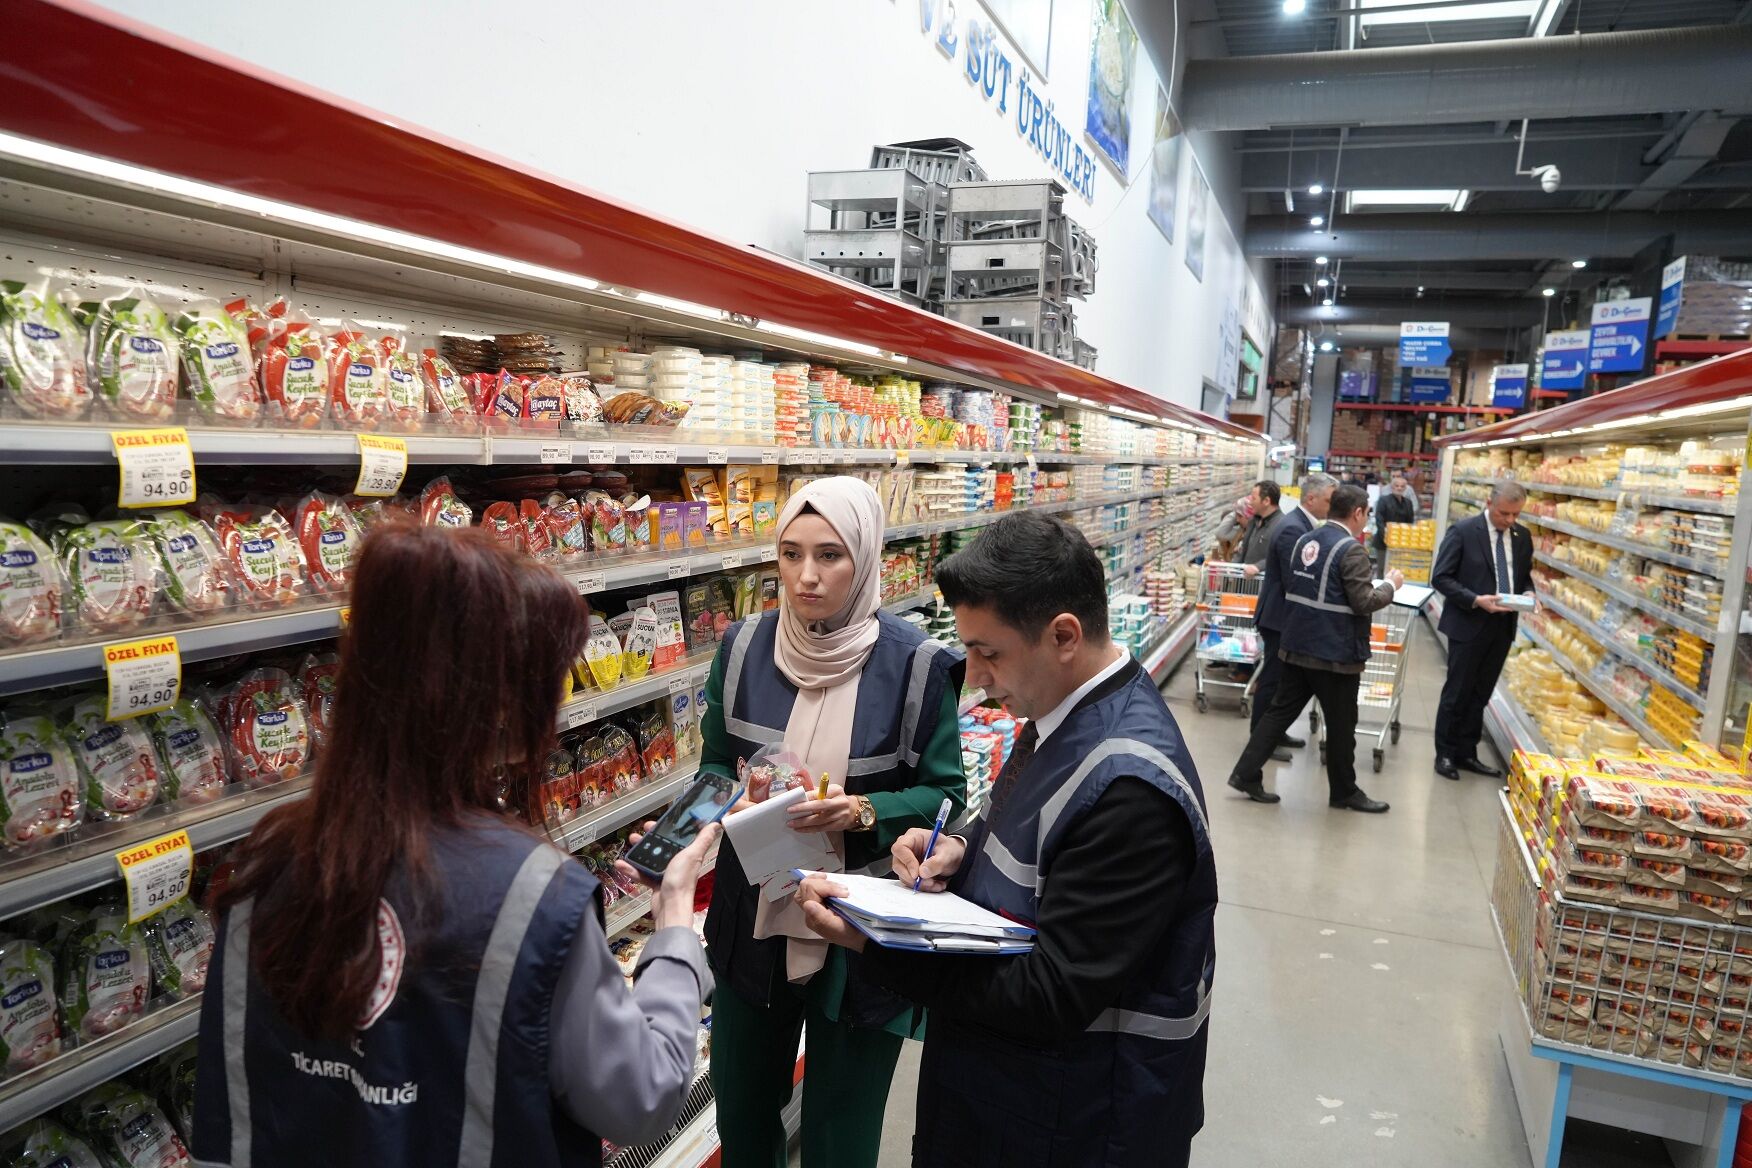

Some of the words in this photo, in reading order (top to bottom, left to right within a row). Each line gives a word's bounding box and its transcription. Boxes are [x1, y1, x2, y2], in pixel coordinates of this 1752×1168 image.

[967, 19, 1012, 114] SÜT
[1018, 66, 1096, 201] ÜRÜNLERİ
[287, 373, 315, 383] Sucuk
[117, 434, 149, 446] ÖZEL
[152, 433, 185, 445] FİYAT
[362, 437, 383, 449] ÖZEL
[144, 481, 187, 498] 94,90
[637, 624, 655, 632] SUCUK
[108, 648, 139, 662] ÖZEL
[143, 642, 175, 656] FİYAT
[129, 689, 172, 708] 94,90
[257, 725, 290, 738] Sucuk
[13, 756, 48, 771] Torku
[121, 848, 153, 866] ÖZEL
[154, 835, 186, 854] FİYAT
[7, 984, 38, 1006] Torku
[291, 1050, 351, 1082] TİCARET
